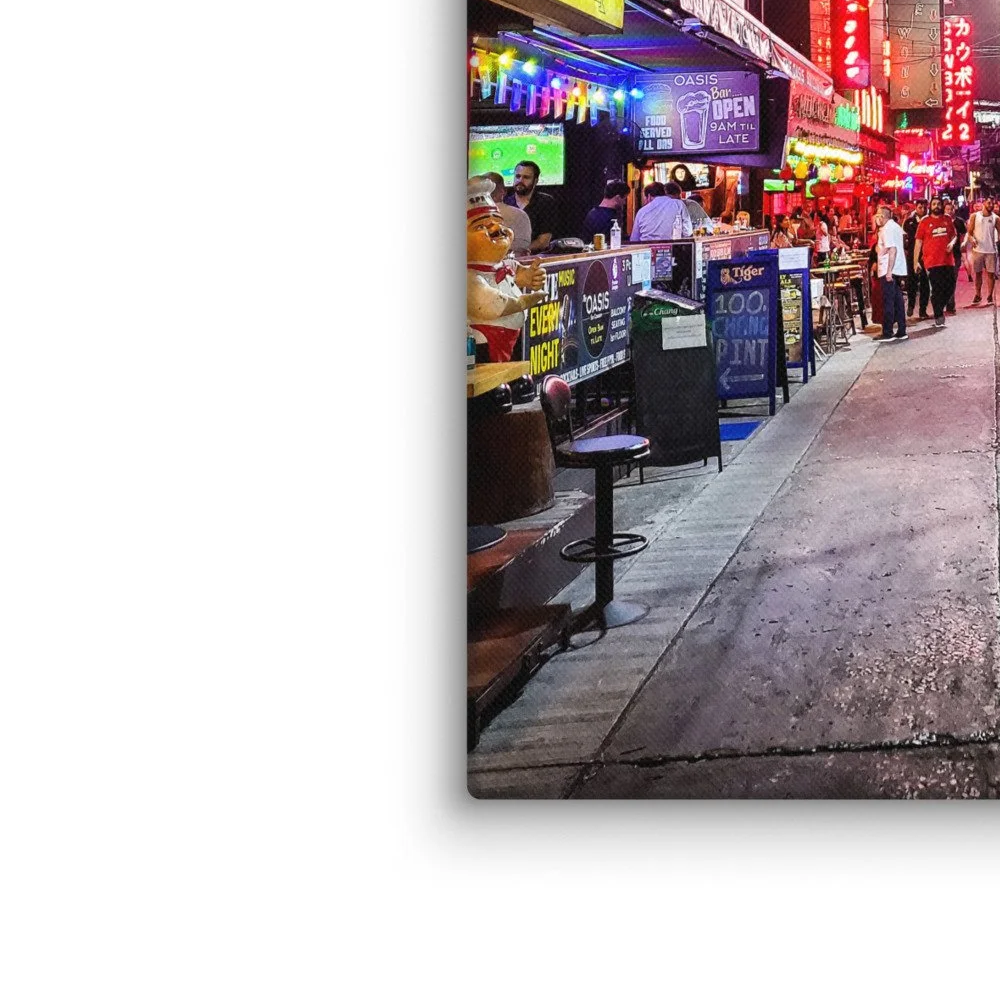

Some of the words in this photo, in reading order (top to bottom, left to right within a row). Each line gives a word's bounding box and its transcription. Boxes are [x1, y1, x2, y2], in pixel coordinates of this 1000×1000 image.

[674, 74, 719, 86] OASIS
[711, 95, 756, 121] OPEN
[645, 114, 667, 126] FOOD
[710, 121, 737, 132] 9AM
[739, 123, 756, 131] TIL
[640, 126, 672, 138] SERVED
[718, 133, 750, 144] LATE
[655, 138, 673, 150] DAY
[558, 268, 575, 287] MUSIC
[731, 265, 764, 282] Tiger
[586, 291, 610, 314] OASIS
[529, 303, 561, 337] EVERY
[653, 306, 678, 317] Chang
[712, 316, 769, 338] CHANG
[529, 339, 560, 375] NIGHT
[717, 338, 769, 365] PINT
